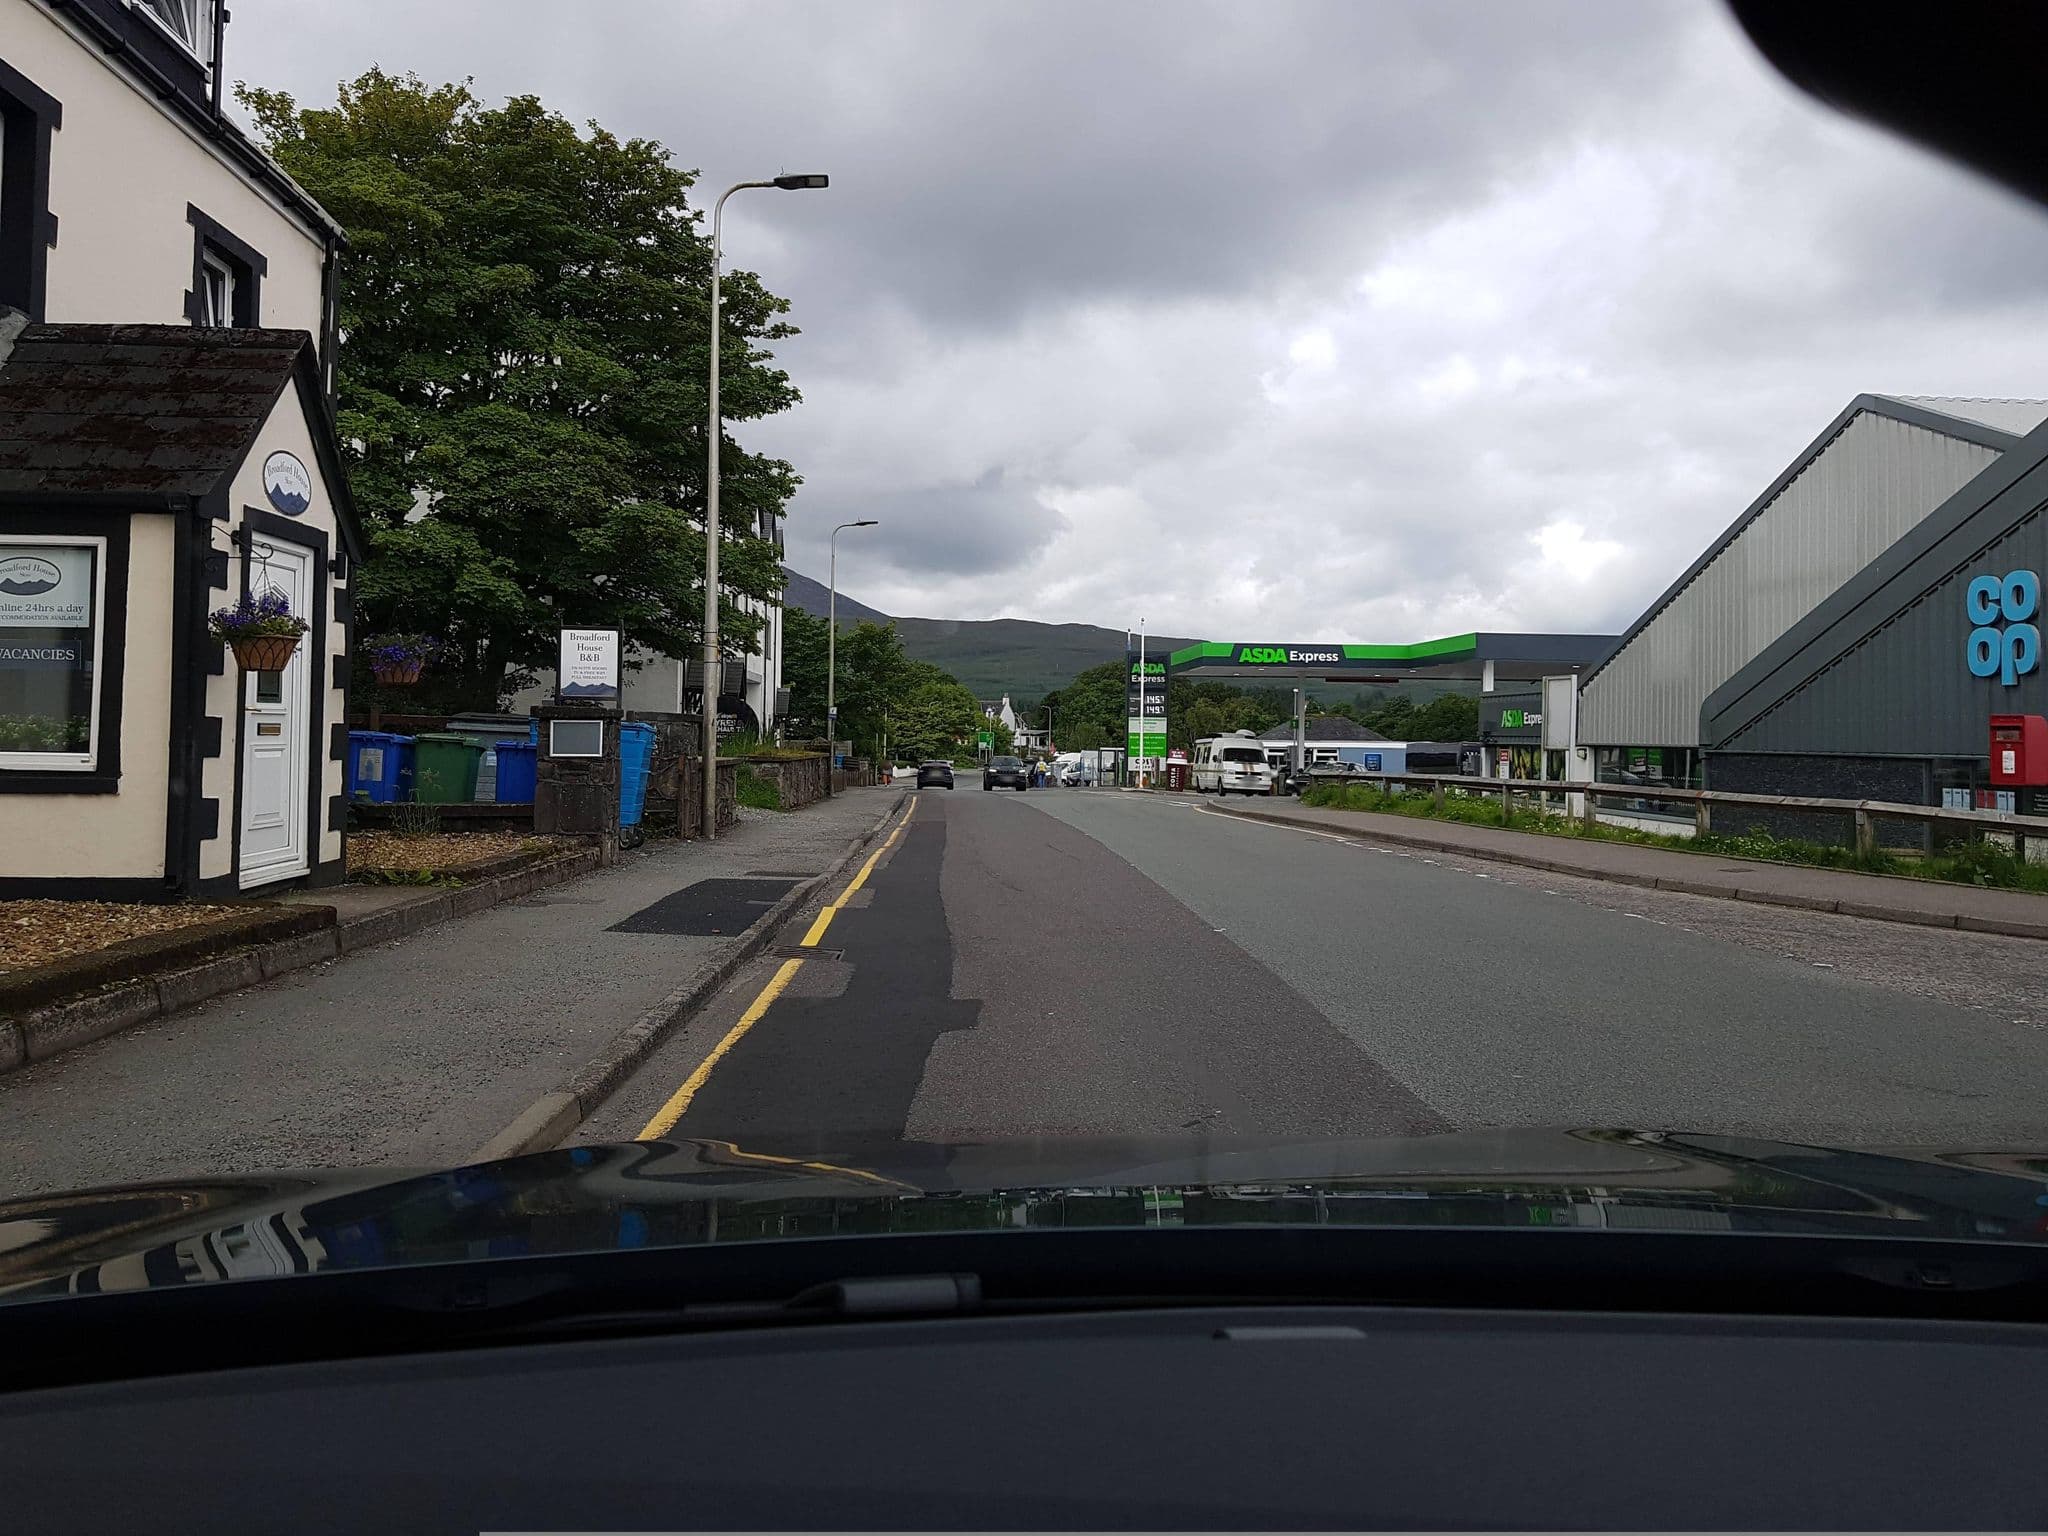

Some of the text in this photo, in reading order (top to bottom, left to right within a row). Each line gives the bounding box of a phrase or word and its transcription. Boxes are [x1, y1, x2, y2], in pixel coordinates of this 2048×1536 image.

[25, 603, 55, 612] 24hrs
[66, 603, 84, 615] day
[570, 632, 611, 641] Broadford
[577, 643, 603, 652] House
[580, 653, 600, 662] B&B
[1239, 647, 1339, 663] ASDA Express
[1501, 709, 1542, 728] ASDA Expre
